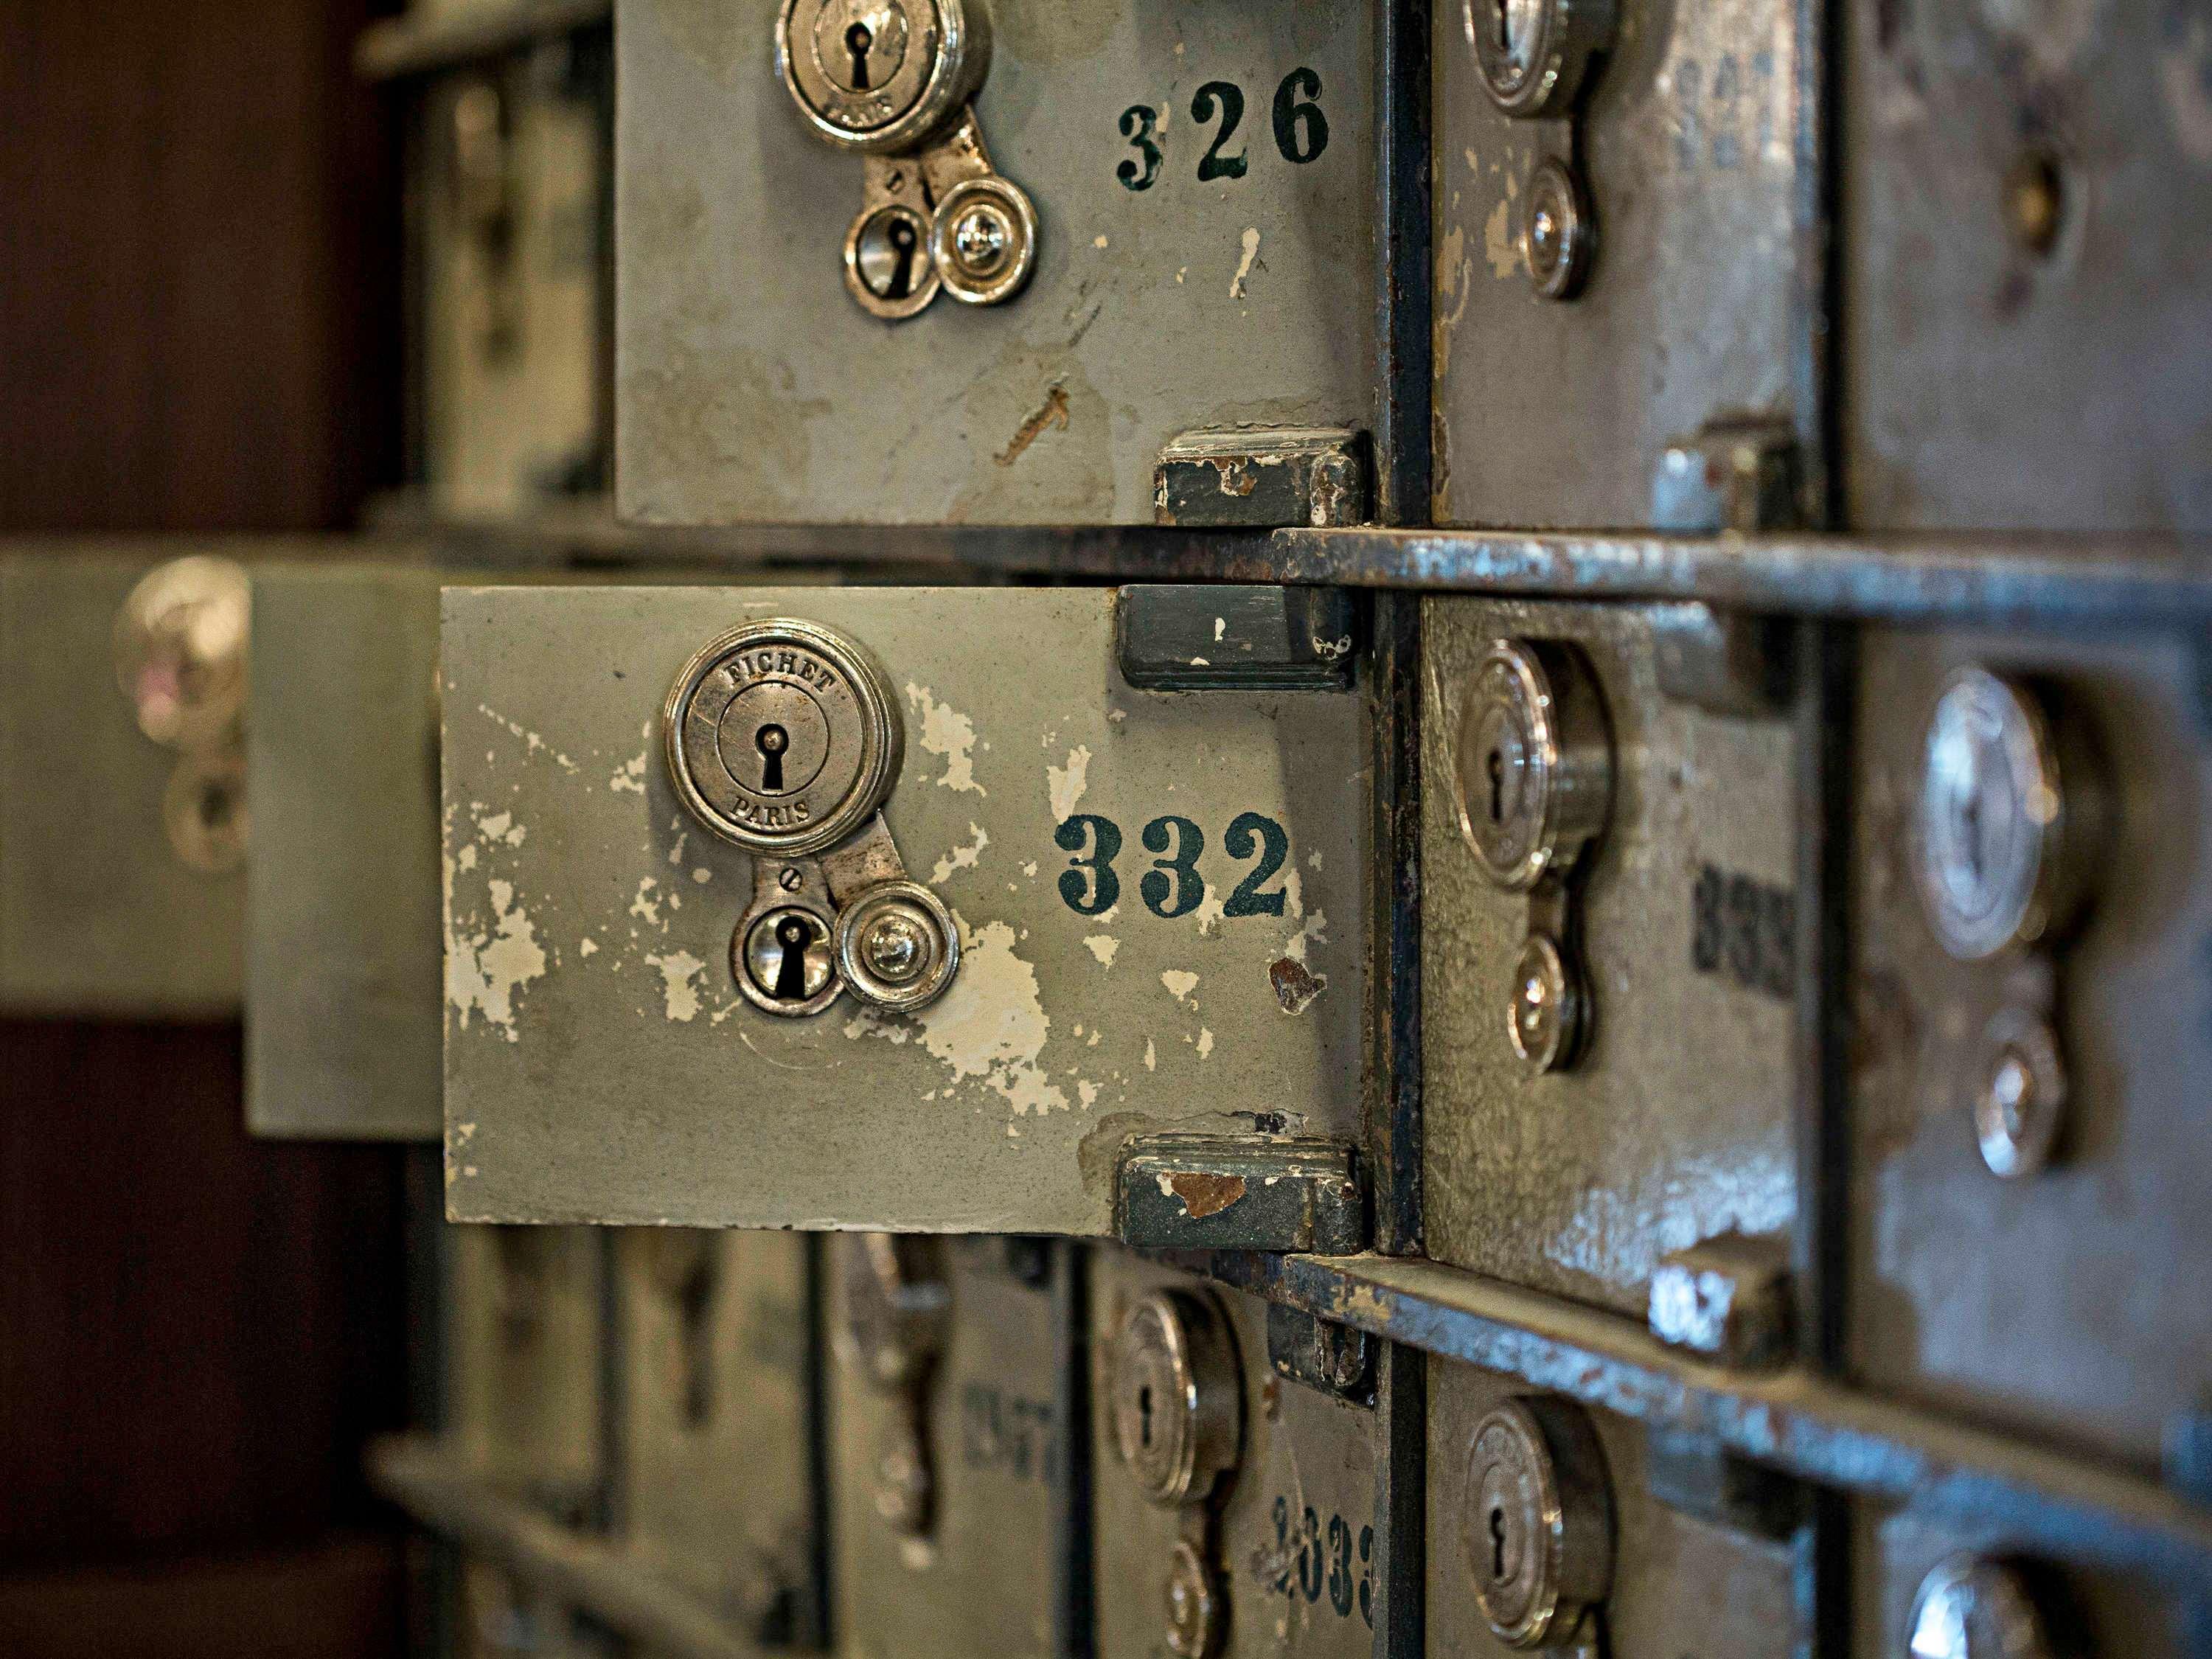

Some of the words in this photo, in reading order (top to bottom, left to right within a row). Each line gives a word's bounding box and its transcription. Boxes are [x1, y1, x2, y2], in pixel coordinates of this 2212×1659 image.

[1116, 66, 1329, 192] 326
[721, 652, 838, 693] FICHET
[731, 796, 810, 827] PARIS
[1054, 812, 1289, 919] 332
